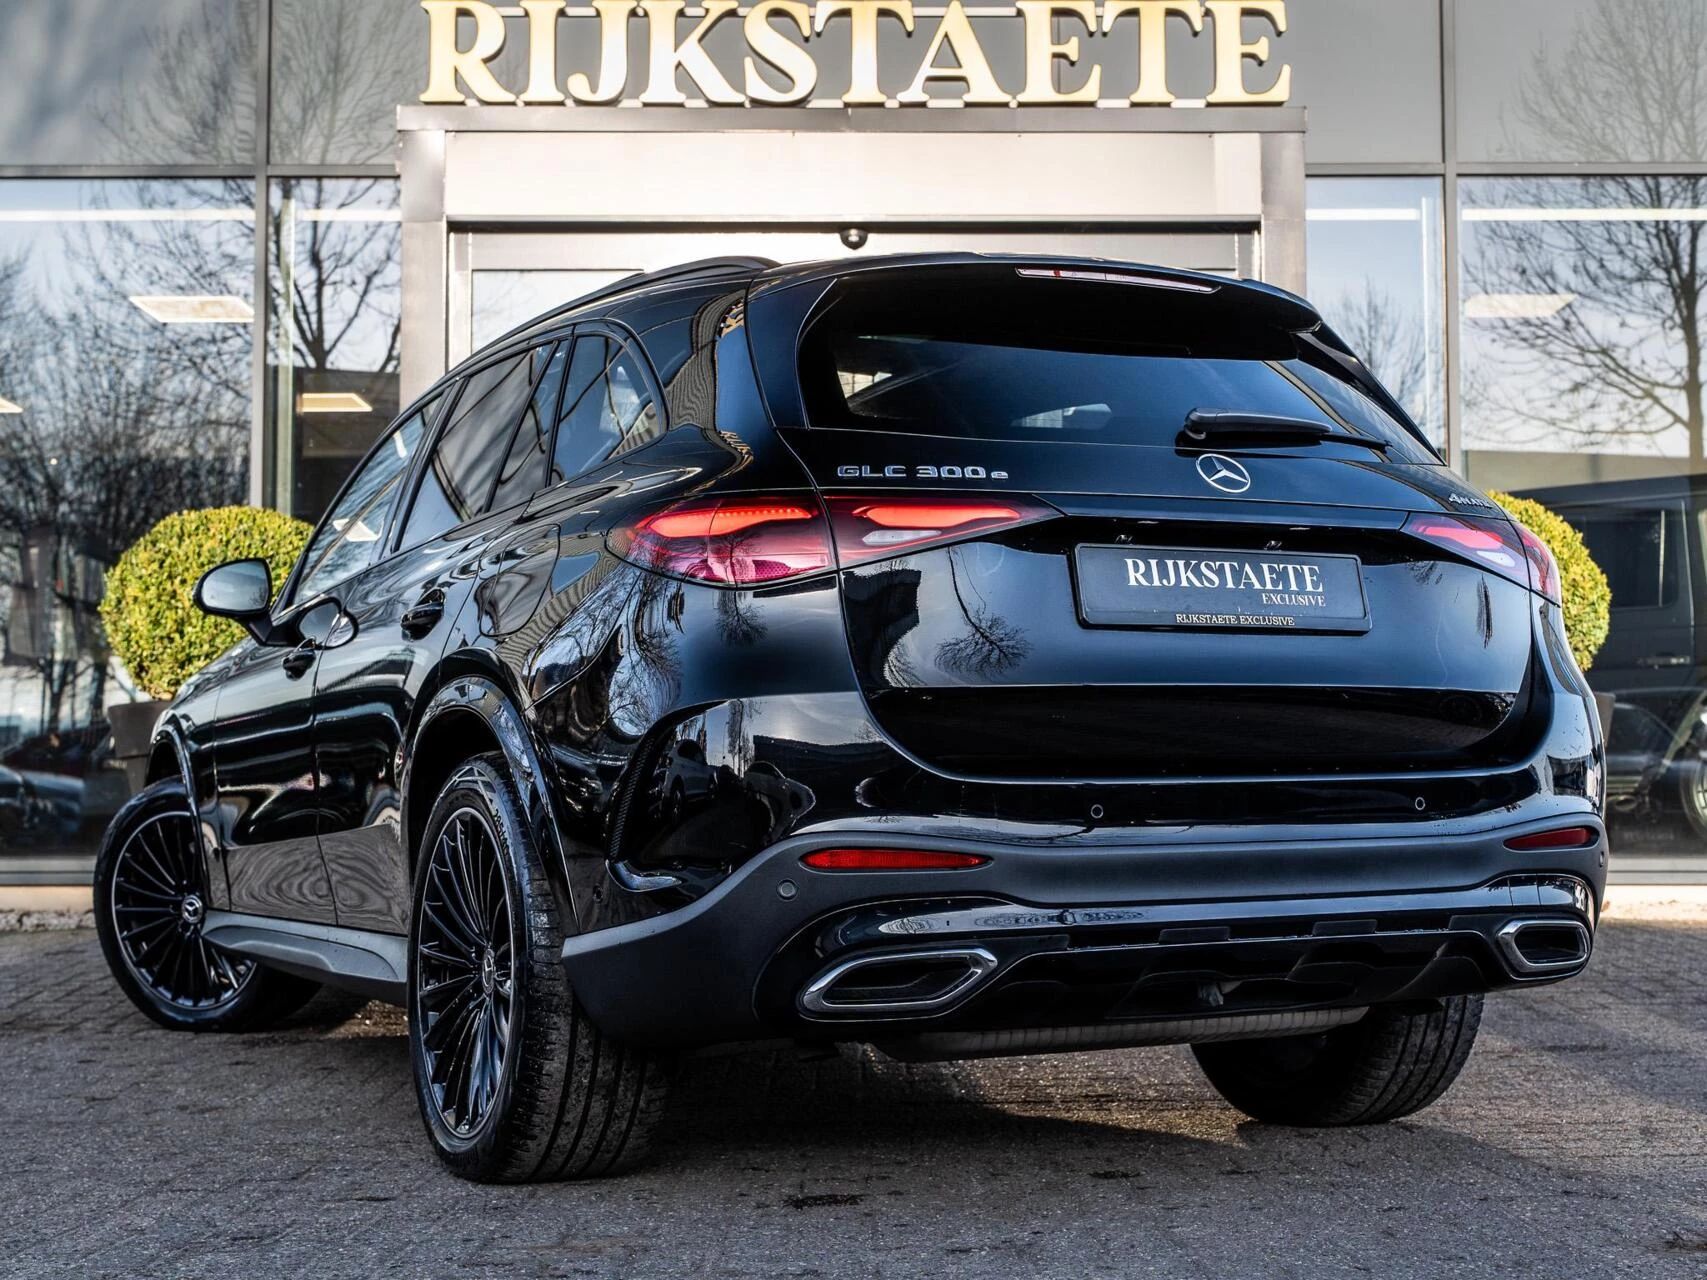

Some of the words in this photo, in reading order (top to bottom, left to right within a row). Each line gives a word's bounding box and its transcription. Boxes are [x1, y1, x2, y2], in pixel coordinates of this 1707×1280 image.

[419, 0, 1291, 106] RIJKSTAETE
[837, 465, 906, 477] GLC
[1125, 558, 1323, 592] RIJKSTAETE
[1262, 593, 1326, 607] EXCLUSIVE
[1176, 614, 1237, 624] RIJKSTAETE
[1240, 615, 1295, 626] EXCLUSIVE
